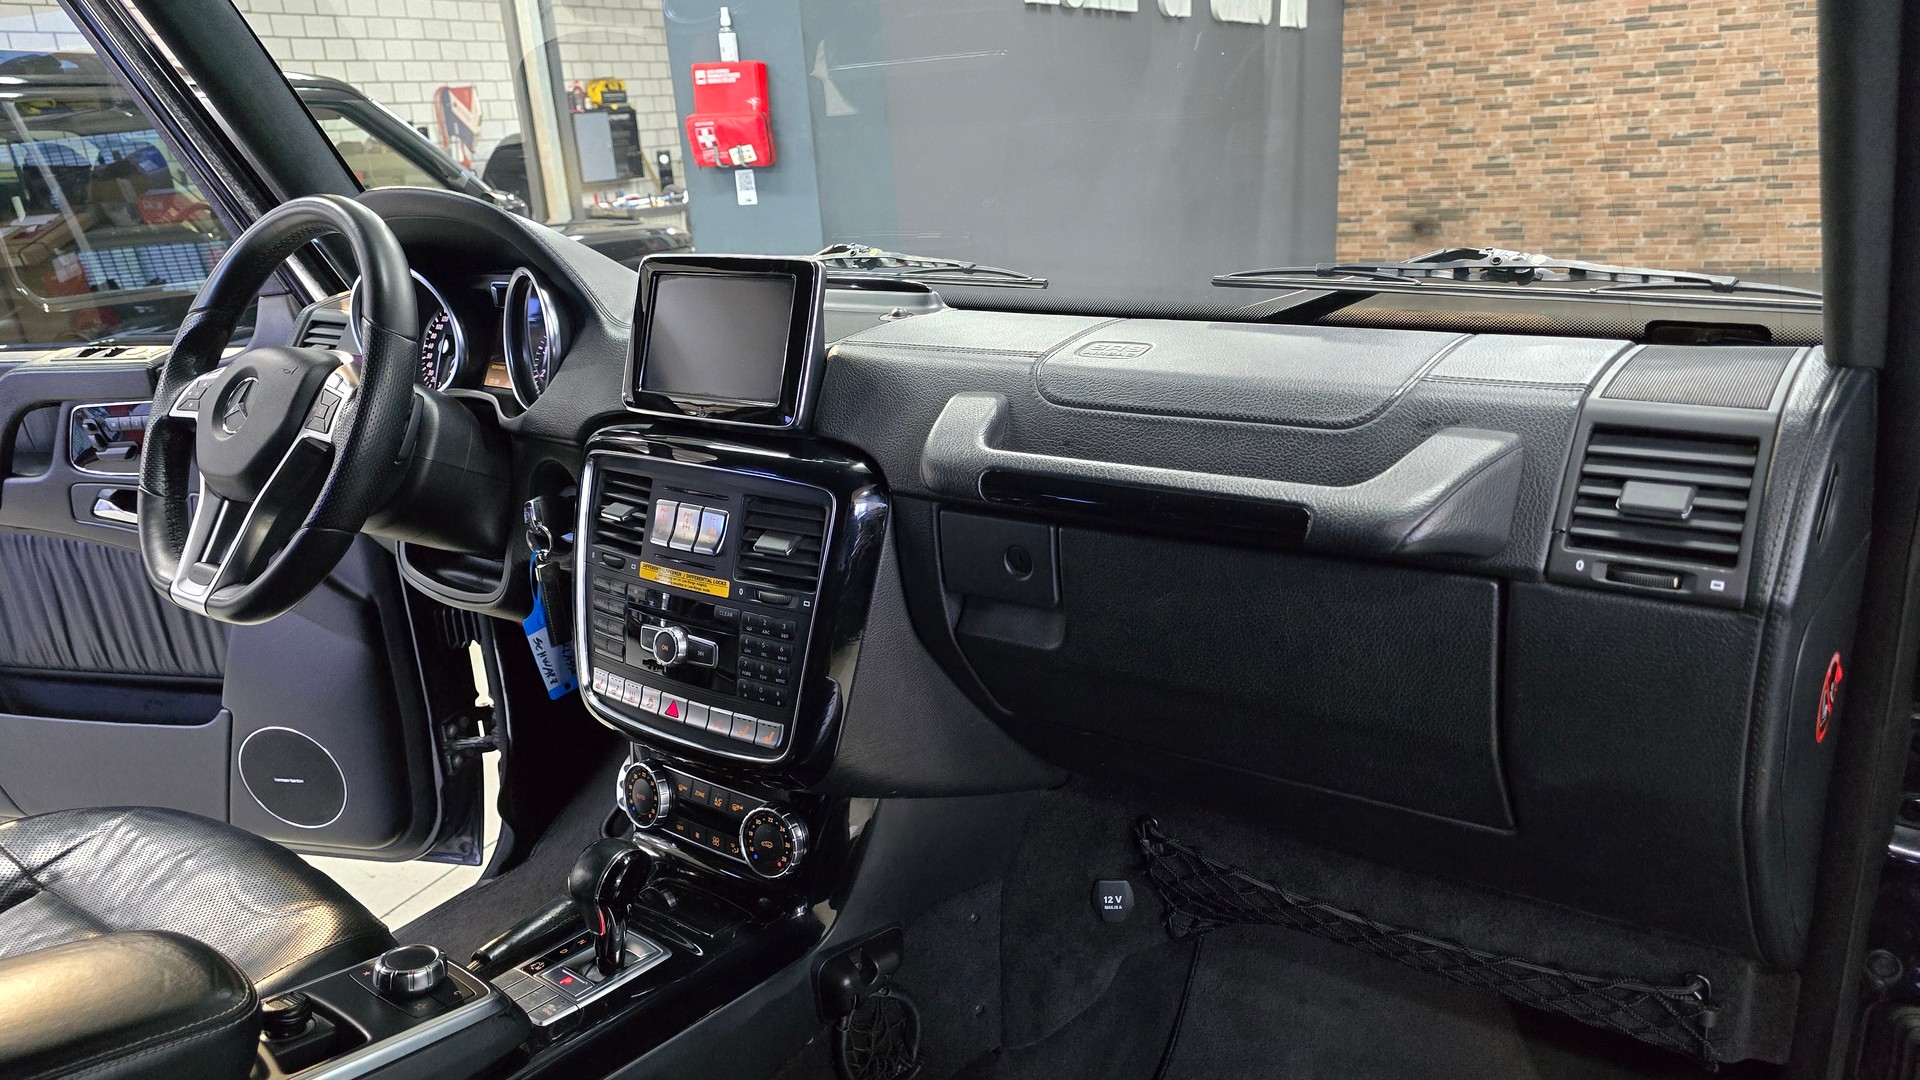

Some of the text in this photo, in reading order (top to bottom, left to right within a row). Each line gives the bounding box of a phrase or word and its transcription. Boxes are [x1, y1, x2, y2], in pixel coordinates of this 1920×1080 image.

[686, 573, 713, 584] DIFFERENTIAL
[712, 578, 727, 587] LOCKS
[533, 637, 558, 685] SCHWARZ
[1103, 895, 1122, 904] 12 V
[559, 976, 574, 985] P
